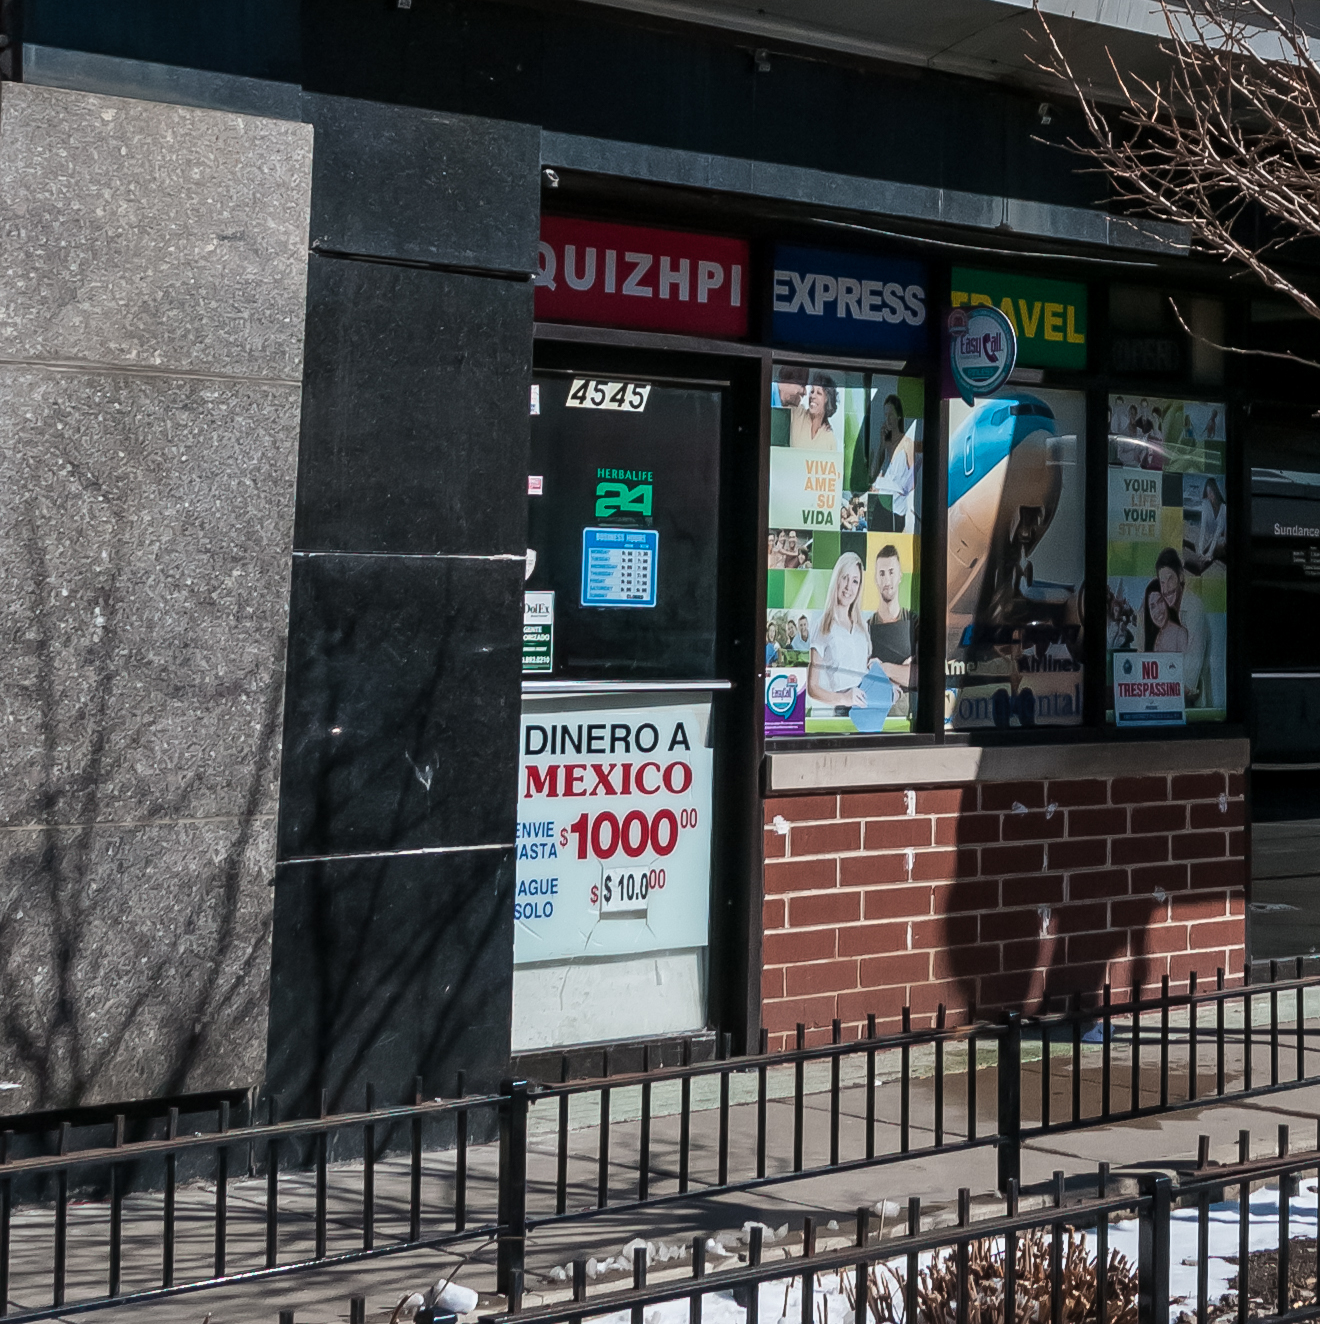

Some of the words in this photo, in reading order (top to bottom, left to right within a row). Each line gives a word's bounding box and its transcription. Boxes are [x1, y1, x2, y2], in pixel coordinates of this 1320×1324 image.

[534, 241, 741, 307] QUIZHPI
[773, 269, 926, 327] EXPRESS
[569, 379, 645, 409] 4545
[597, 468, 653, 482] HERBALIFE
[805, 459, 841, 479] VIVA,
[804, 478, 836, 492] AME
[1124, 479, 1157, 493] YOUR
[595, 482, 653, 517] 24
[817, 494, 835, 509] SU
[802, 509, 834, 526] VIDA
[1124, 508, 1156, 522] YOUR
[1274, 523, 1320, 537] Sundance
[1142, 661, 1159, 680] NO
[1118, 682, 1181, 698] TRESPASSING
[524, 722, 659, 756] DINERO
[668, 722, 691, 752] A
[524, 761, 693, 799] MEXICO
[518, 878, 558, 896] AGUE
[514, 901, 553, 920] SOLO
